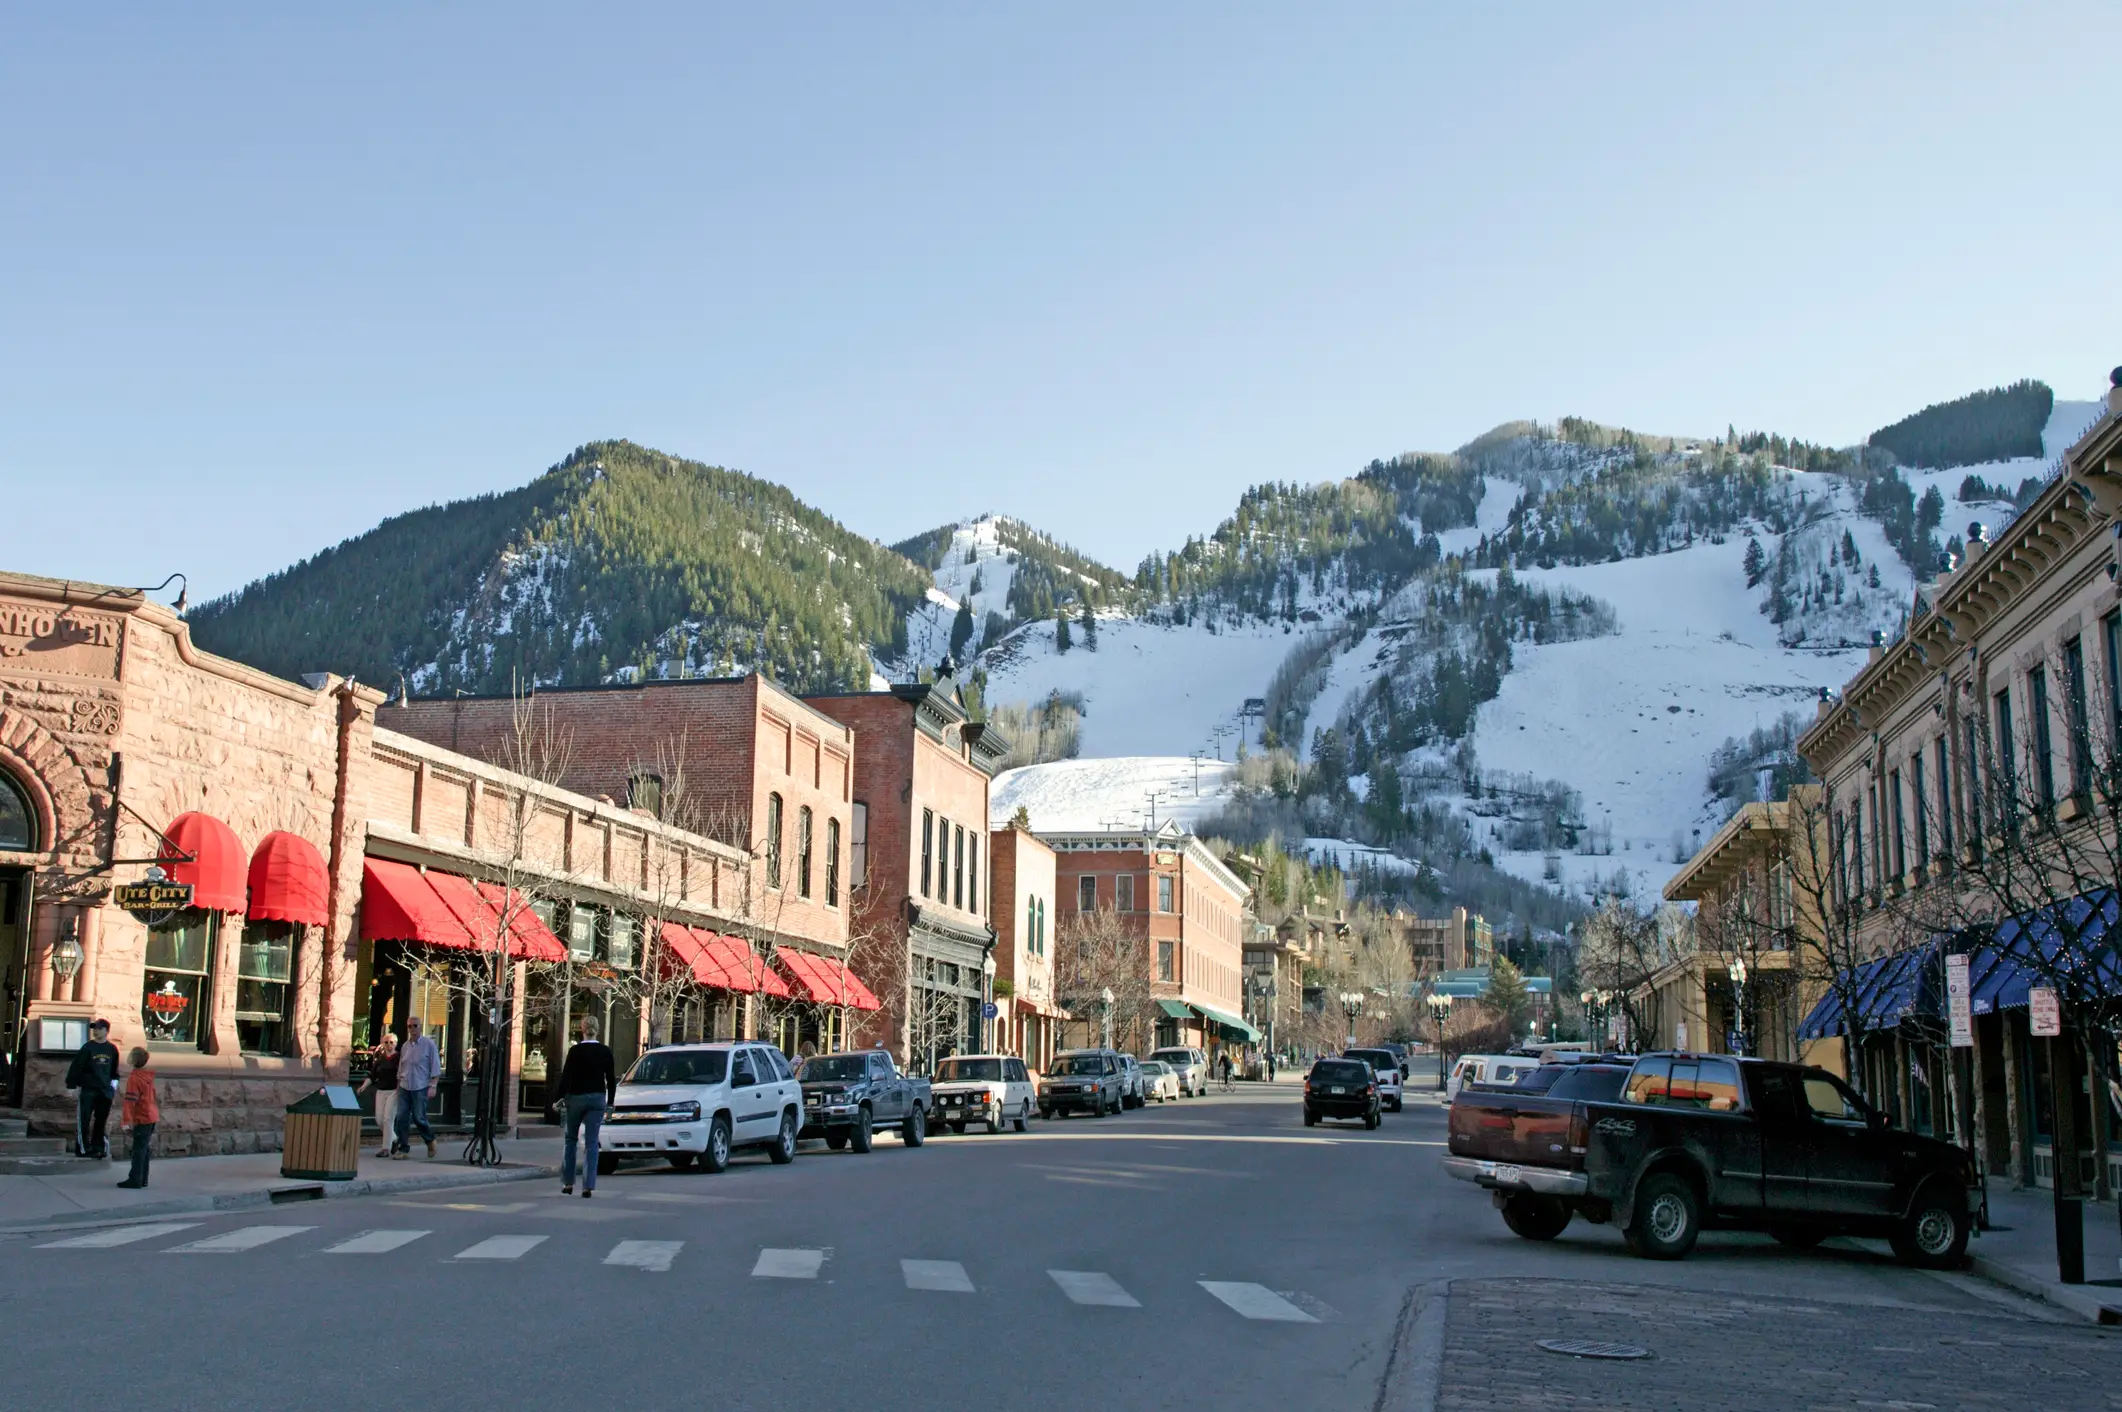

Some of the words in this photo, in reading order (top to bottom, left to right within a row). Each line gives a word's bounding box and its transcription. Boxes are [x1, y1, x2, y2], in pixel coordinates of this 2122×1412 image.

[115, 886, 148, 903] UTE
[150, 885, 188, 902] CITY
[986, 1004, 994, 1016] P
